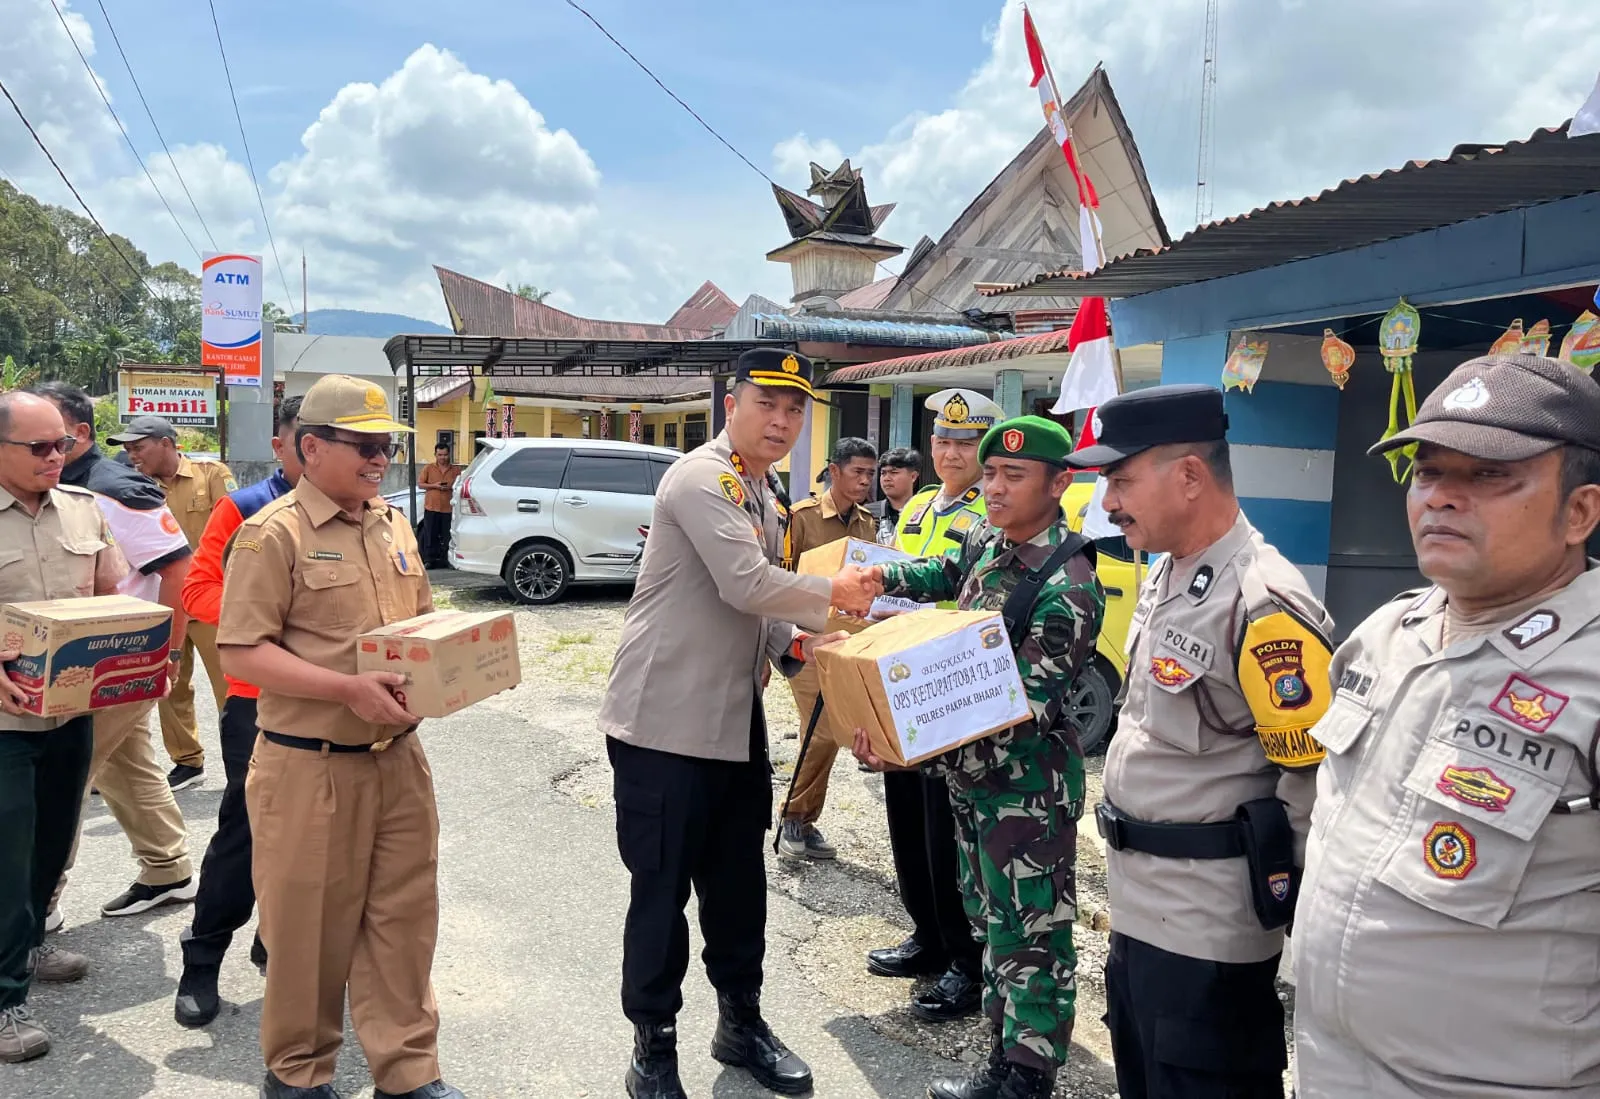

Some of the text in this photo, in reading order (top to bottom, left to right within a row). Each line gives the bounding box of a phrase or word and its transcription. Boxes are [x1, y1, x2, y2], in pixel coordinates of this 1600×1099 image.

[214, 272, 249, 286] ATM
[131, 388, 204, 397] RUMAH MAKAN
[128, 397, 208, 414] Famili
[87, 634, 150, 651] Kari Ayam
[1164, 629, 1208, 662] POLRI
[1256, 641, 1298, 656] POLDA
[921, 648, 976, 676] BINGKISAN
[893, 690, 911, 711] OPS
[910, 673, 954, 707] KETUPAT
[952, 664, 977, 691] TOBA
[993, 653, 1011, 675] 2026
[915, 684, 1004, 726] POLRES PAKPAK BHARAT
[1453, 718, 1555, 771] POLRI
